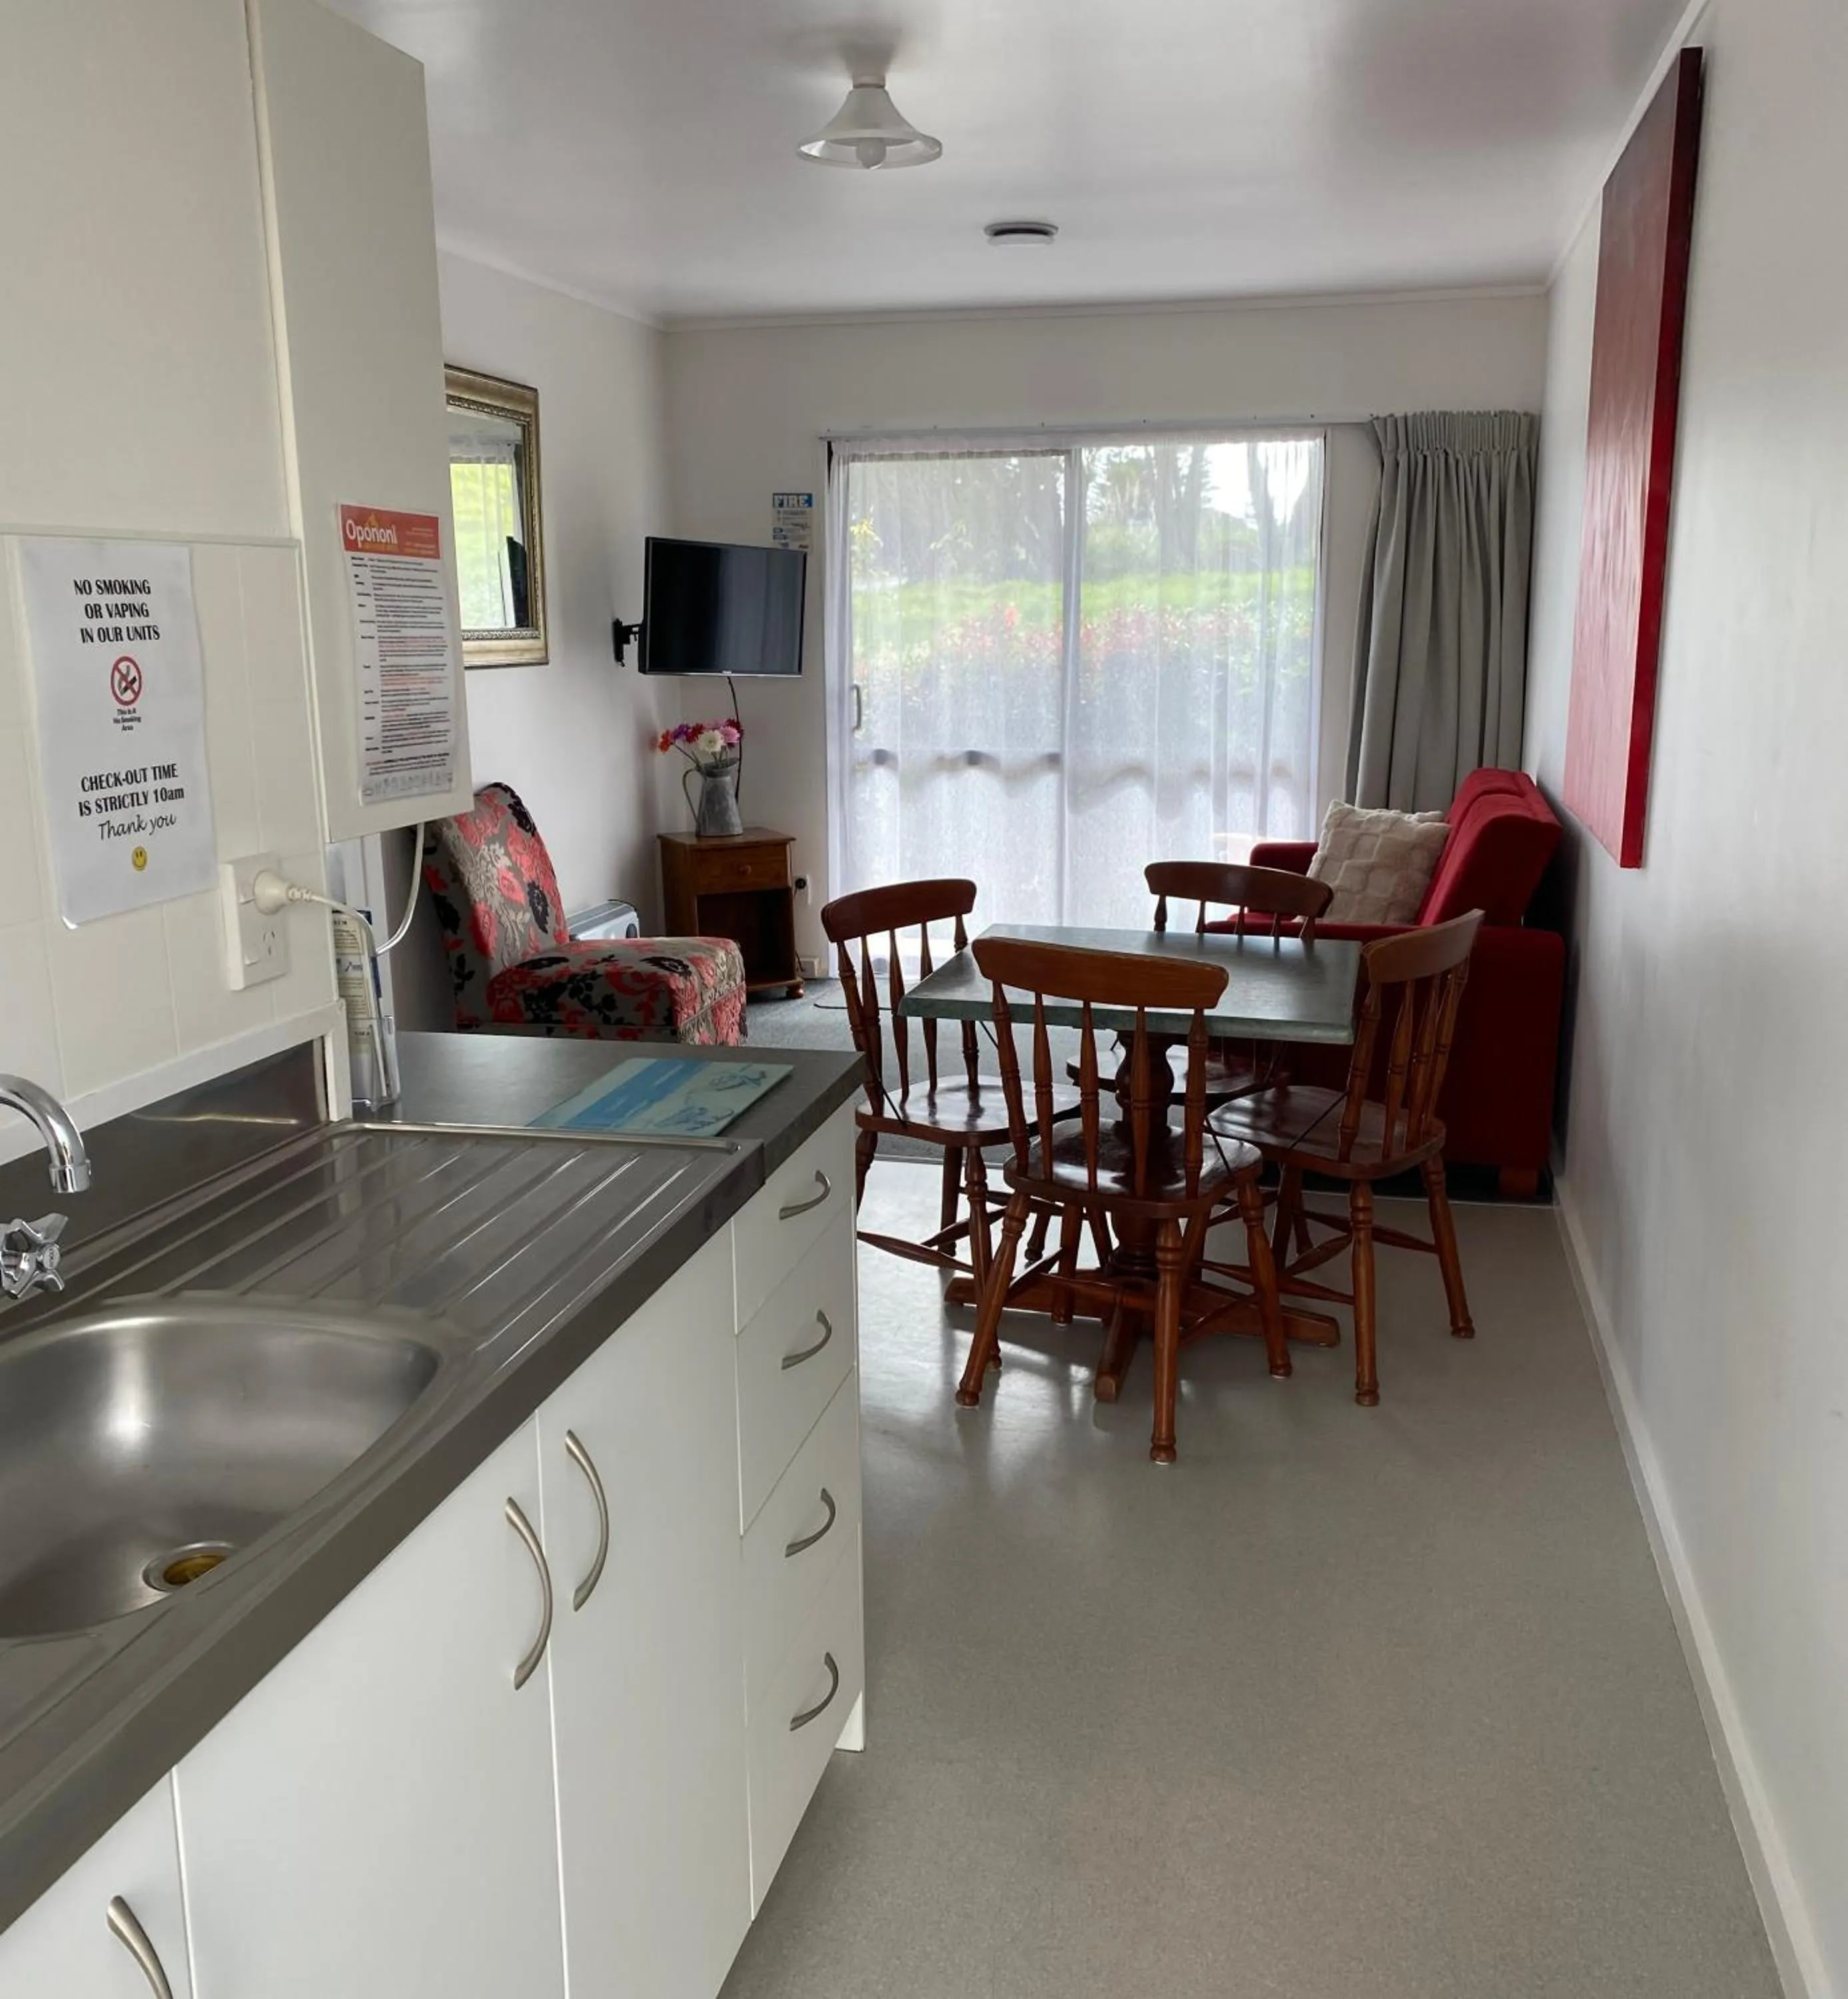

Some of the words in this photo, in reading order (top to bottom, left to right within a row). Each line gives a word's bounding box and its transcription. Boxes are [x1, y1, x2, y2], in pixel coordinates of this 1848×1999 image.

[773, 494, 809, 507] FIRE
[73, 579, 92, 595] NO
[95, 579, 151, 594] SMOKING
[85, 603, 103, 619] OR
[105, 602, 149, 618] VAPING
[81, 627, 94, 643] IN
[97, 626, 123, 642] OUR
[126, 625, 160, 641] UNITS
[81, 768, 147, 792] CHECK-OUT
[151, 763, 178, 781] TIME
[79, 800, 91, 816] IS
[95, 790, 149, 814] STRICTLY
[153, 787, 185, 803] 10am
[98, 814, 147, 840] Thank
[149, 814, 177, 836] you
